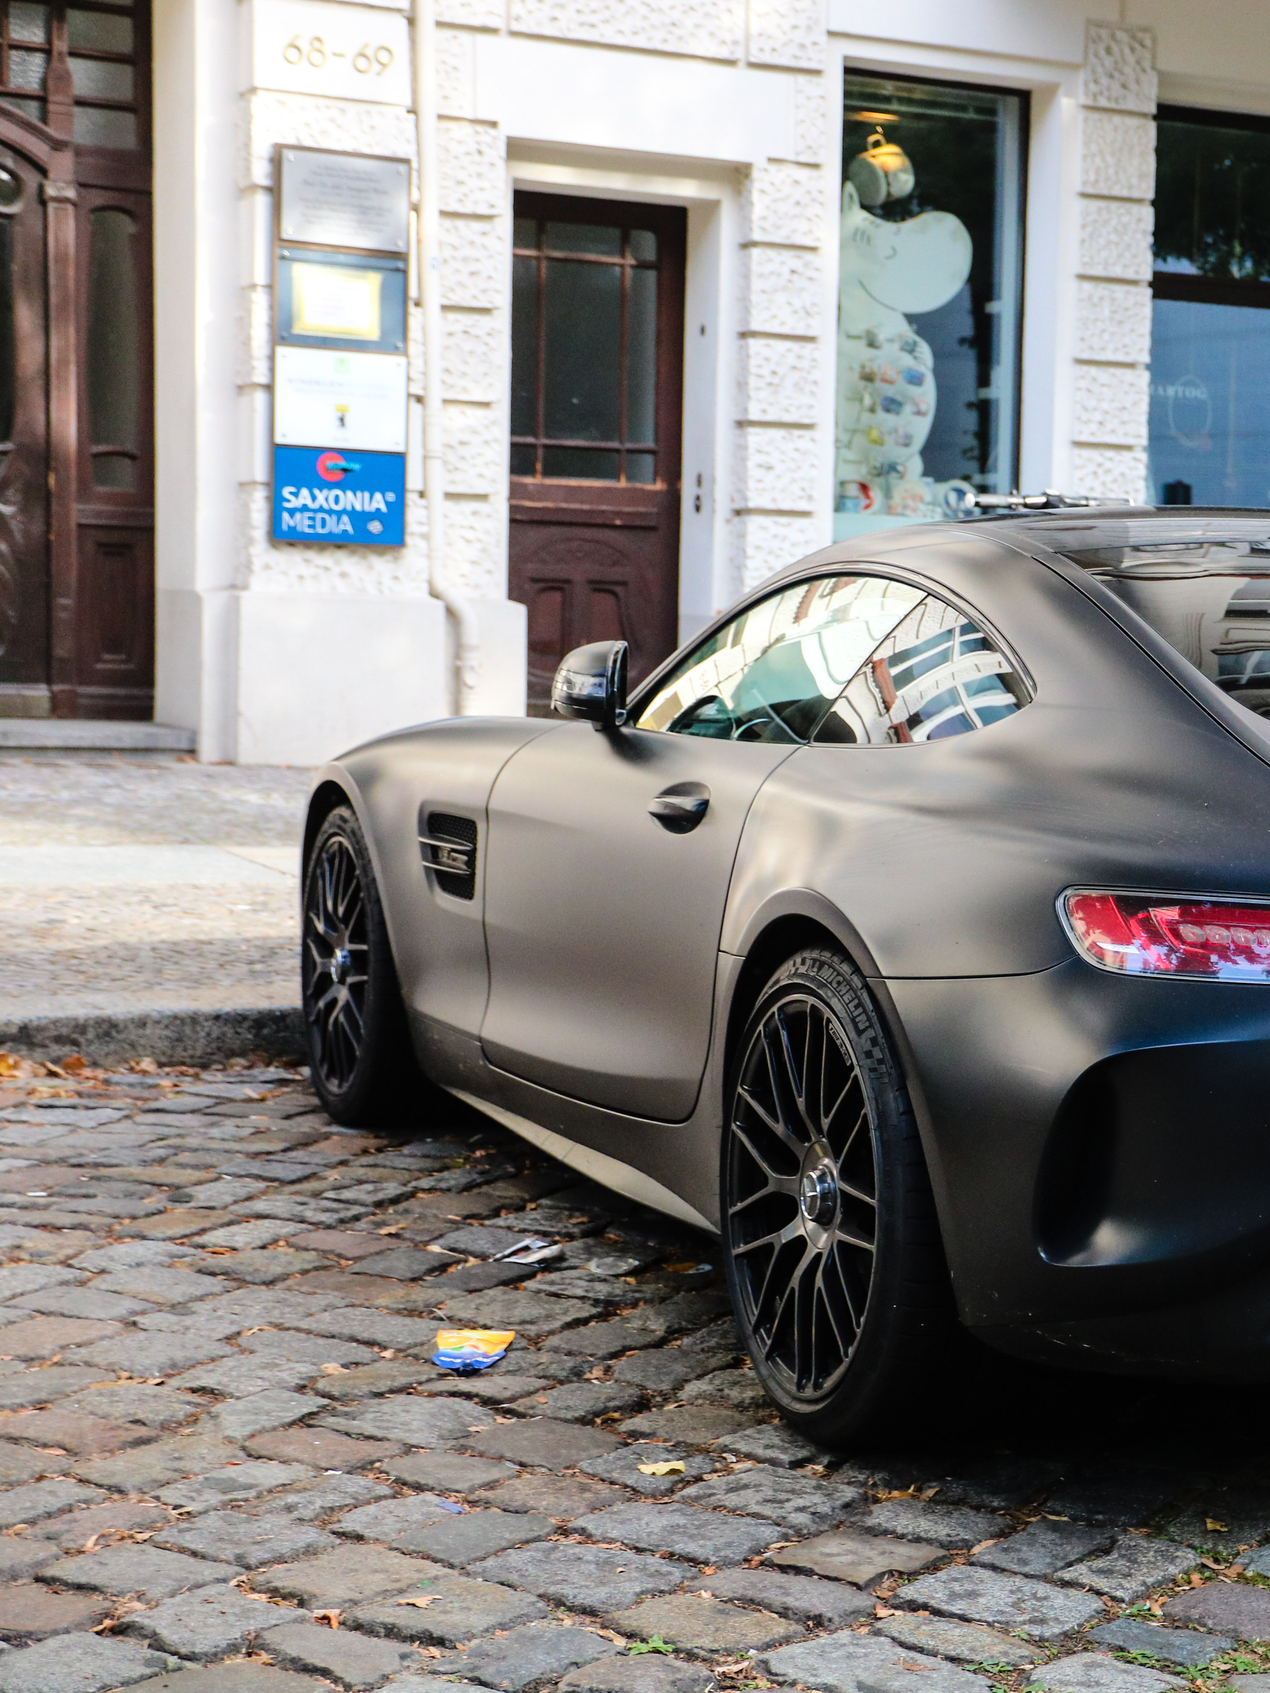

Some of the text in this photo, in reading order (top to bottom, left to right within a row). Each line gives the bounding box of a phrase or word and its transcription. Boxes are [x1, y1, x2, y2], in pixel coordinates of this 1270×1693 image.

[281, 486, 388, 513] SAXONIA
[281, 511, 354, 535] MEDIA
[818, 964, 870, 1031] MICHELIN
